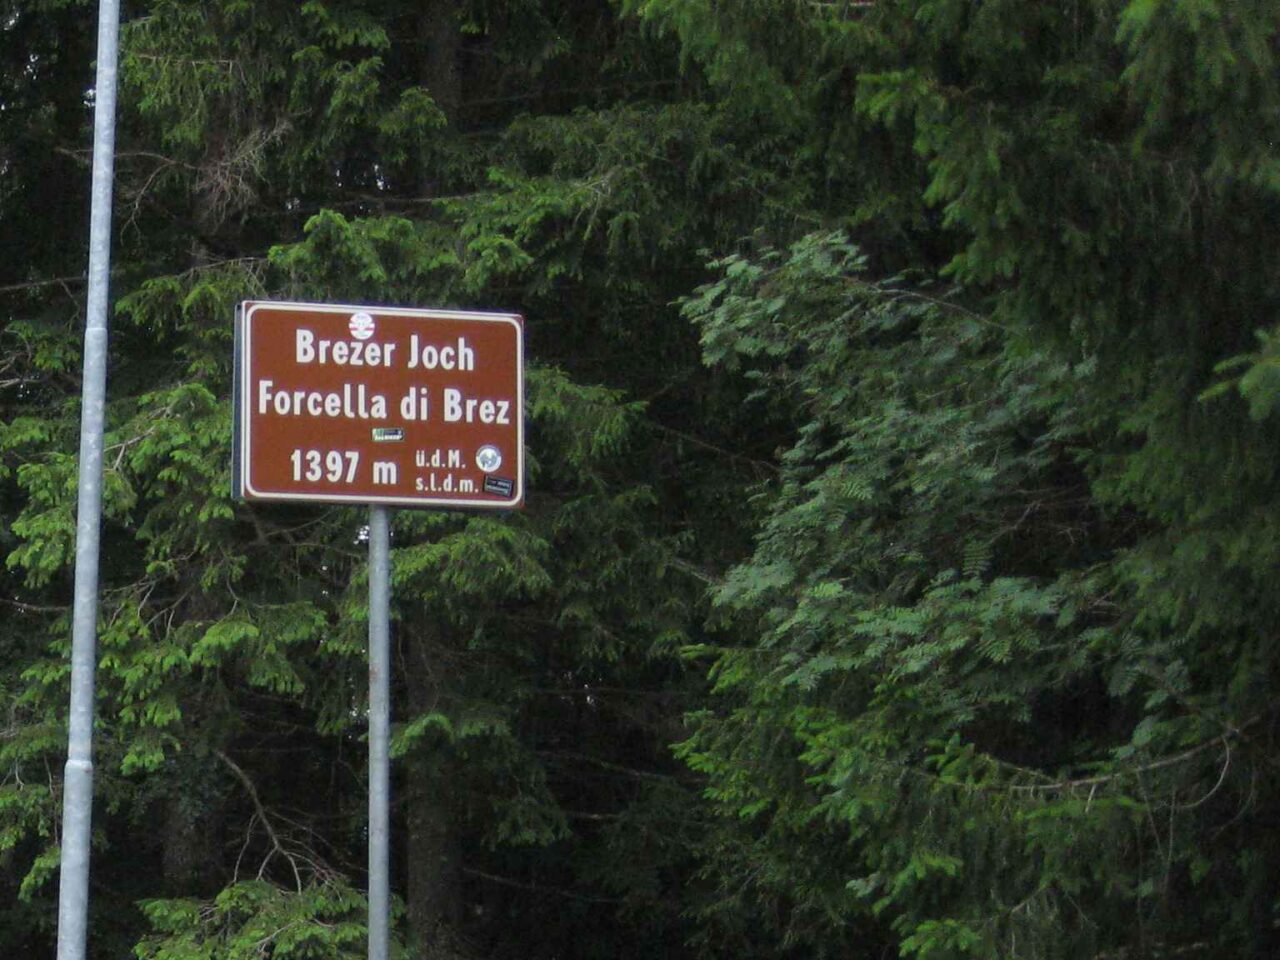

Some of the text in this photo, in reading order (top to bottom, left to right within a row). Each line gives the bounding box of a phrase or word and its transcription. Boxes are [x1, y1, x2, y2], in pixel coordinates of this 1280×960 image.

[295, 328, 474, 371] Brezer Joch
[258, 379, 510, 425] Forcella di Brez
[290, 449, 397, 485] 1397 m
